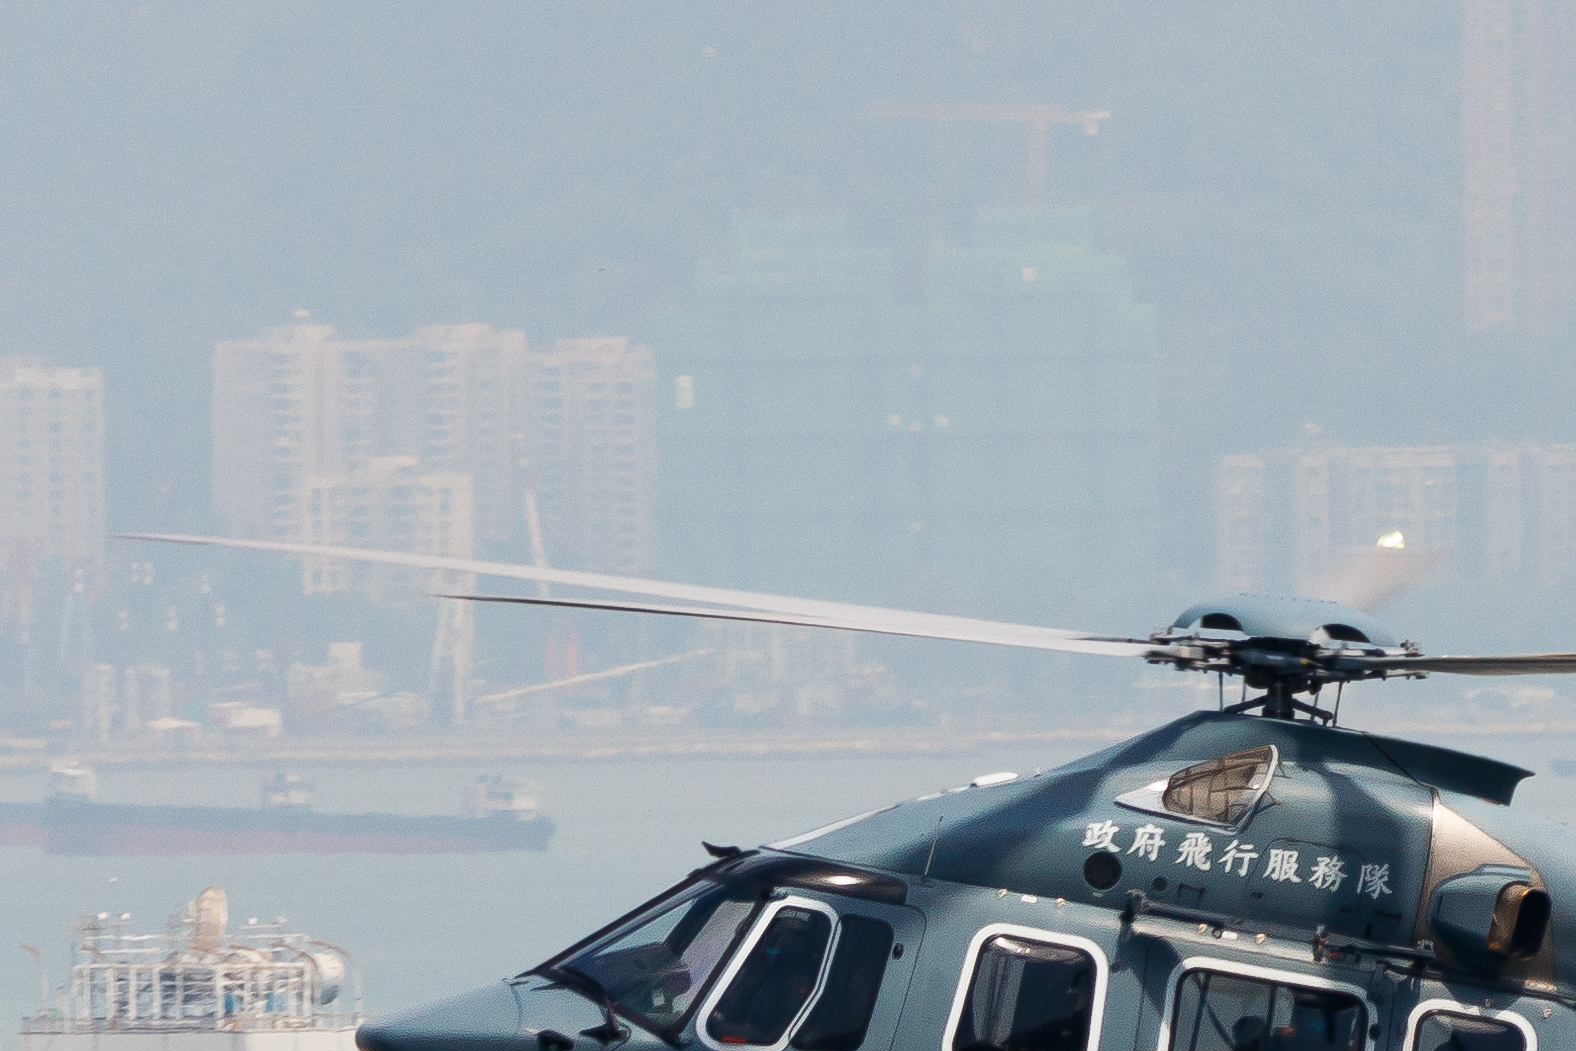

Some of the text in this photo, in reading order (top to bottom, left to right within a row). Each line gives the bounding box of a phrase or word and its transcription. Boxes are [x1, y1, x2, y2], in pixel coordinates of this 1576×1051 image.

[1081, 819, 1393, 900] 政府飛行服務隊
